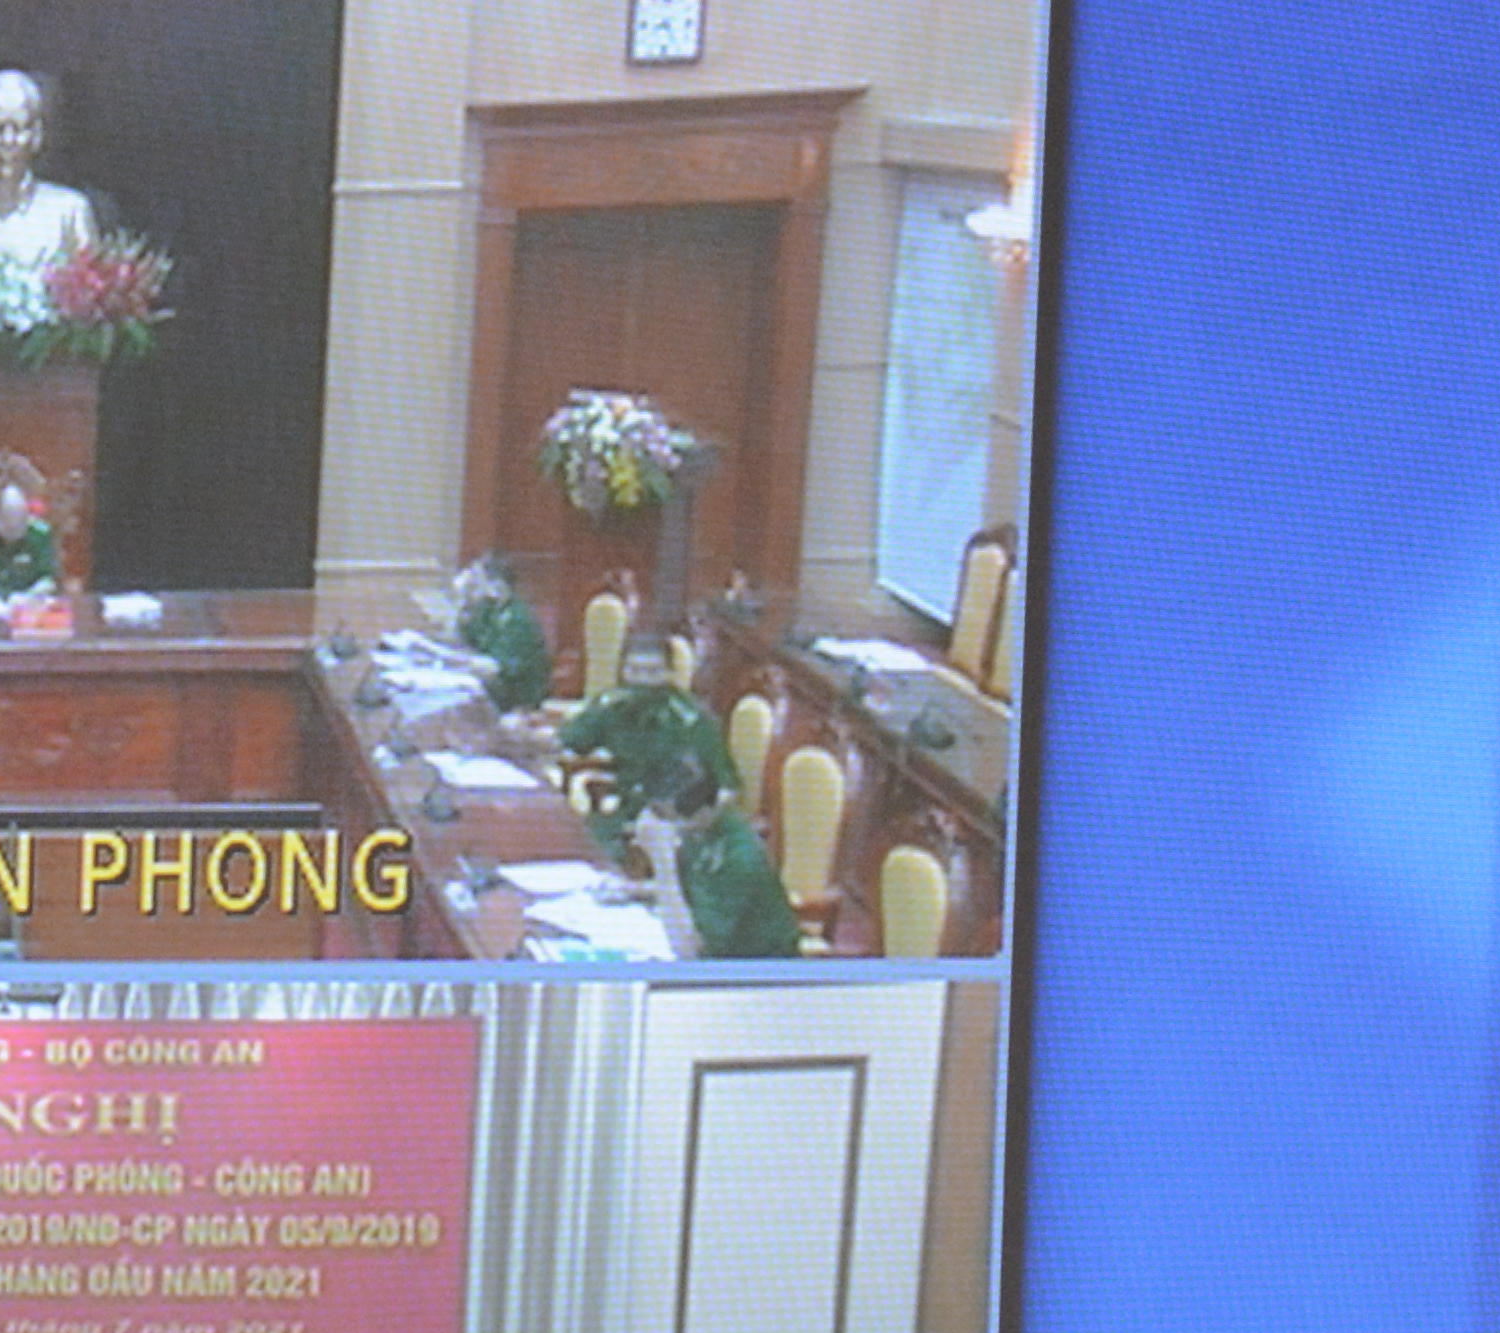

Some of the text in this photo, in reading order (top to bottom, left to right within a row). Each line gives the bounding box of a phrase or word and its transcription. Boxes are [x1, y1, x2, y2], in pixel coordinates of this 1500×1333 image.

[80, 829, 410, 914] PHONG
[105, 1037, 200, 1065] CÔNG
[212, 1041, 265, 1065] AN
[246, 1266, 321, 1297] 2021
